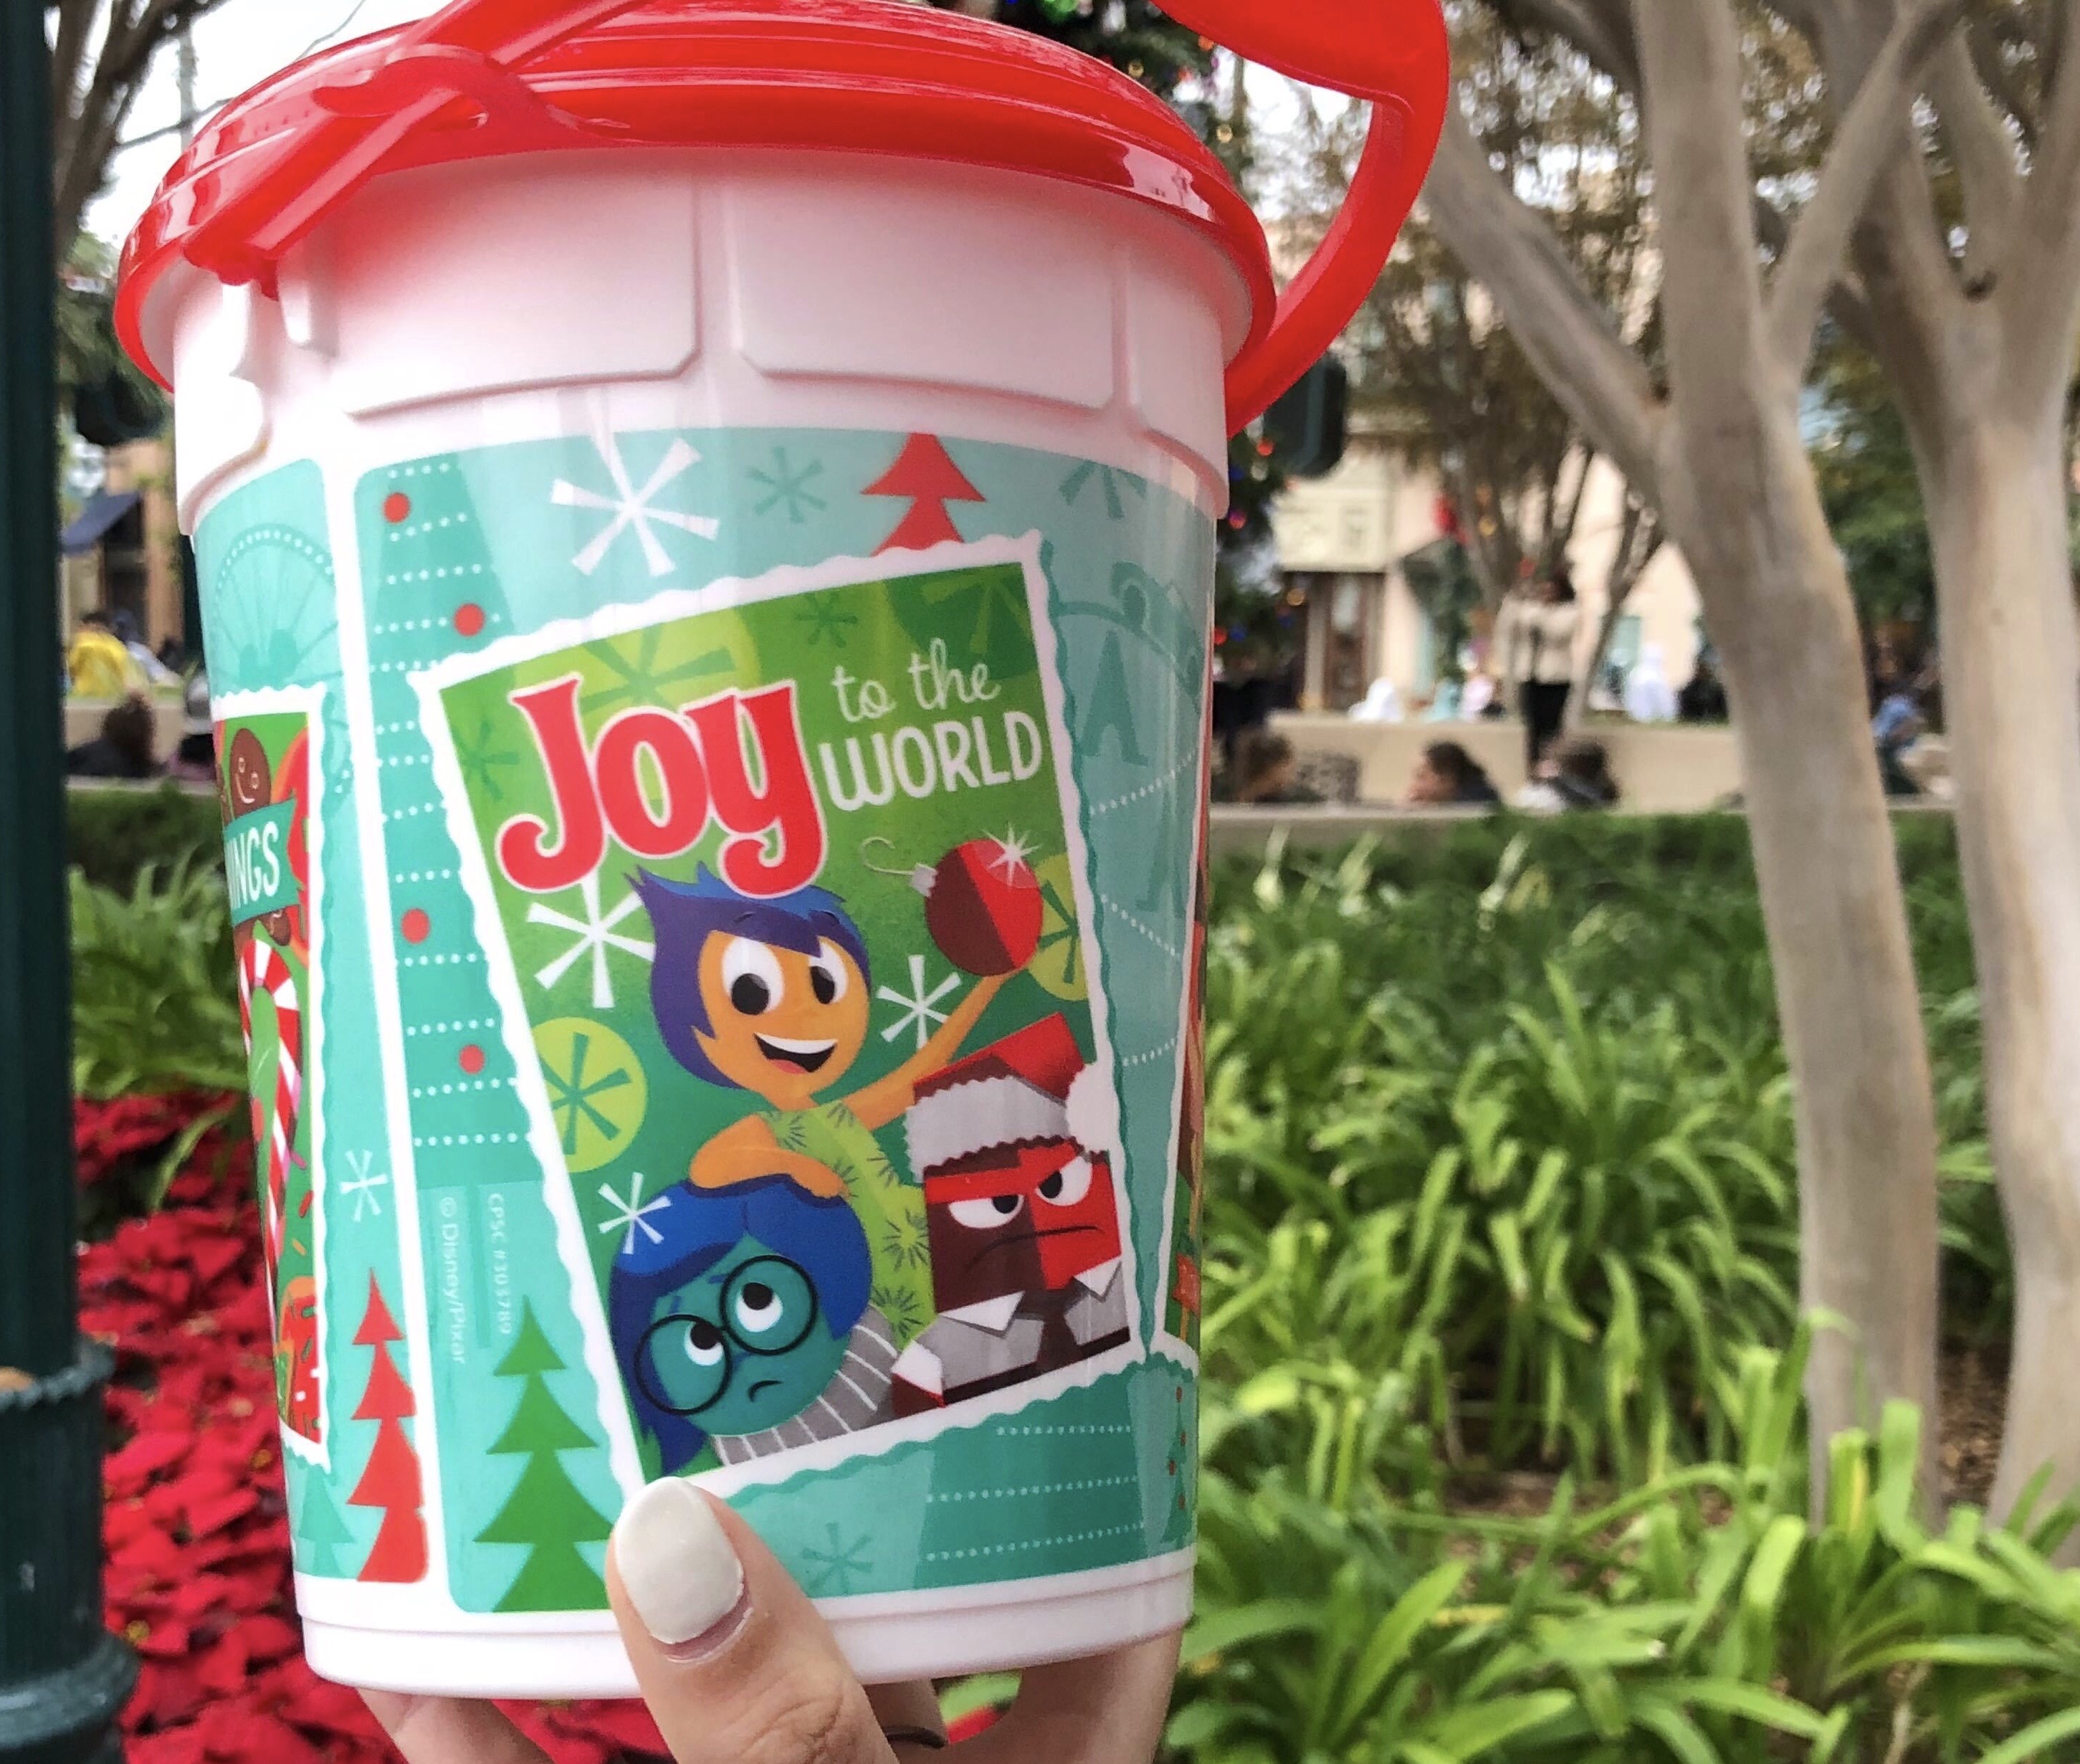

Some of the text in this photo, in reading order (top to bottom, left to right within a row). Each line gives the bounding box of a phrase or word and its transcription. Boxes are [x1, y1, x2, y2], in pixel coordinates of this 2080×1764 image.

[831, 637, 1001, 723] to the
[494, 671, 826, 900] Joy
[819, 710, 1044, 811] WORLD
[487, 1193, 506, 1244] CPSC
[441, 1223, 464, 1363] Disney/Pixar
